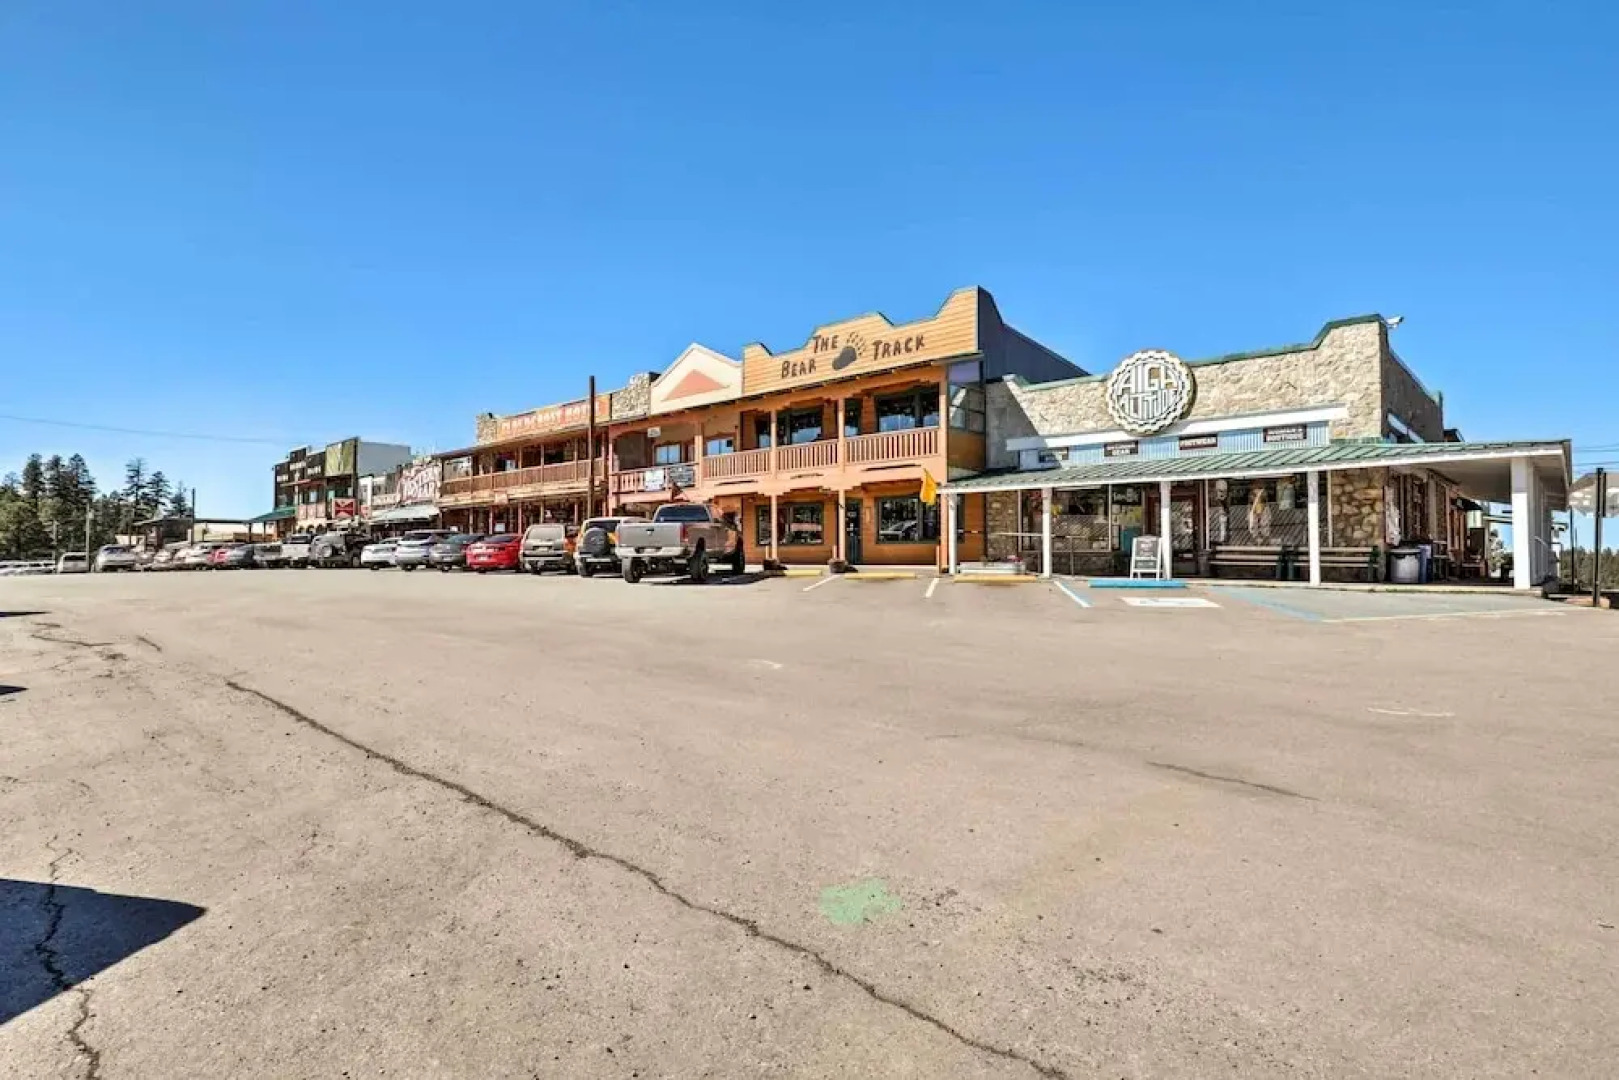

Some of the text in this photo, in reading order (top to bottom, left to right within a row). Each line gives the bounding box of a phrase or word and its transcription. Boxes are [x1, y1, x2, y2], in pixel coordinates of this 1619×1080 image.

[781, 334, 926, 379] BEAR TRACK
[814, 334, 840, 353] THE
